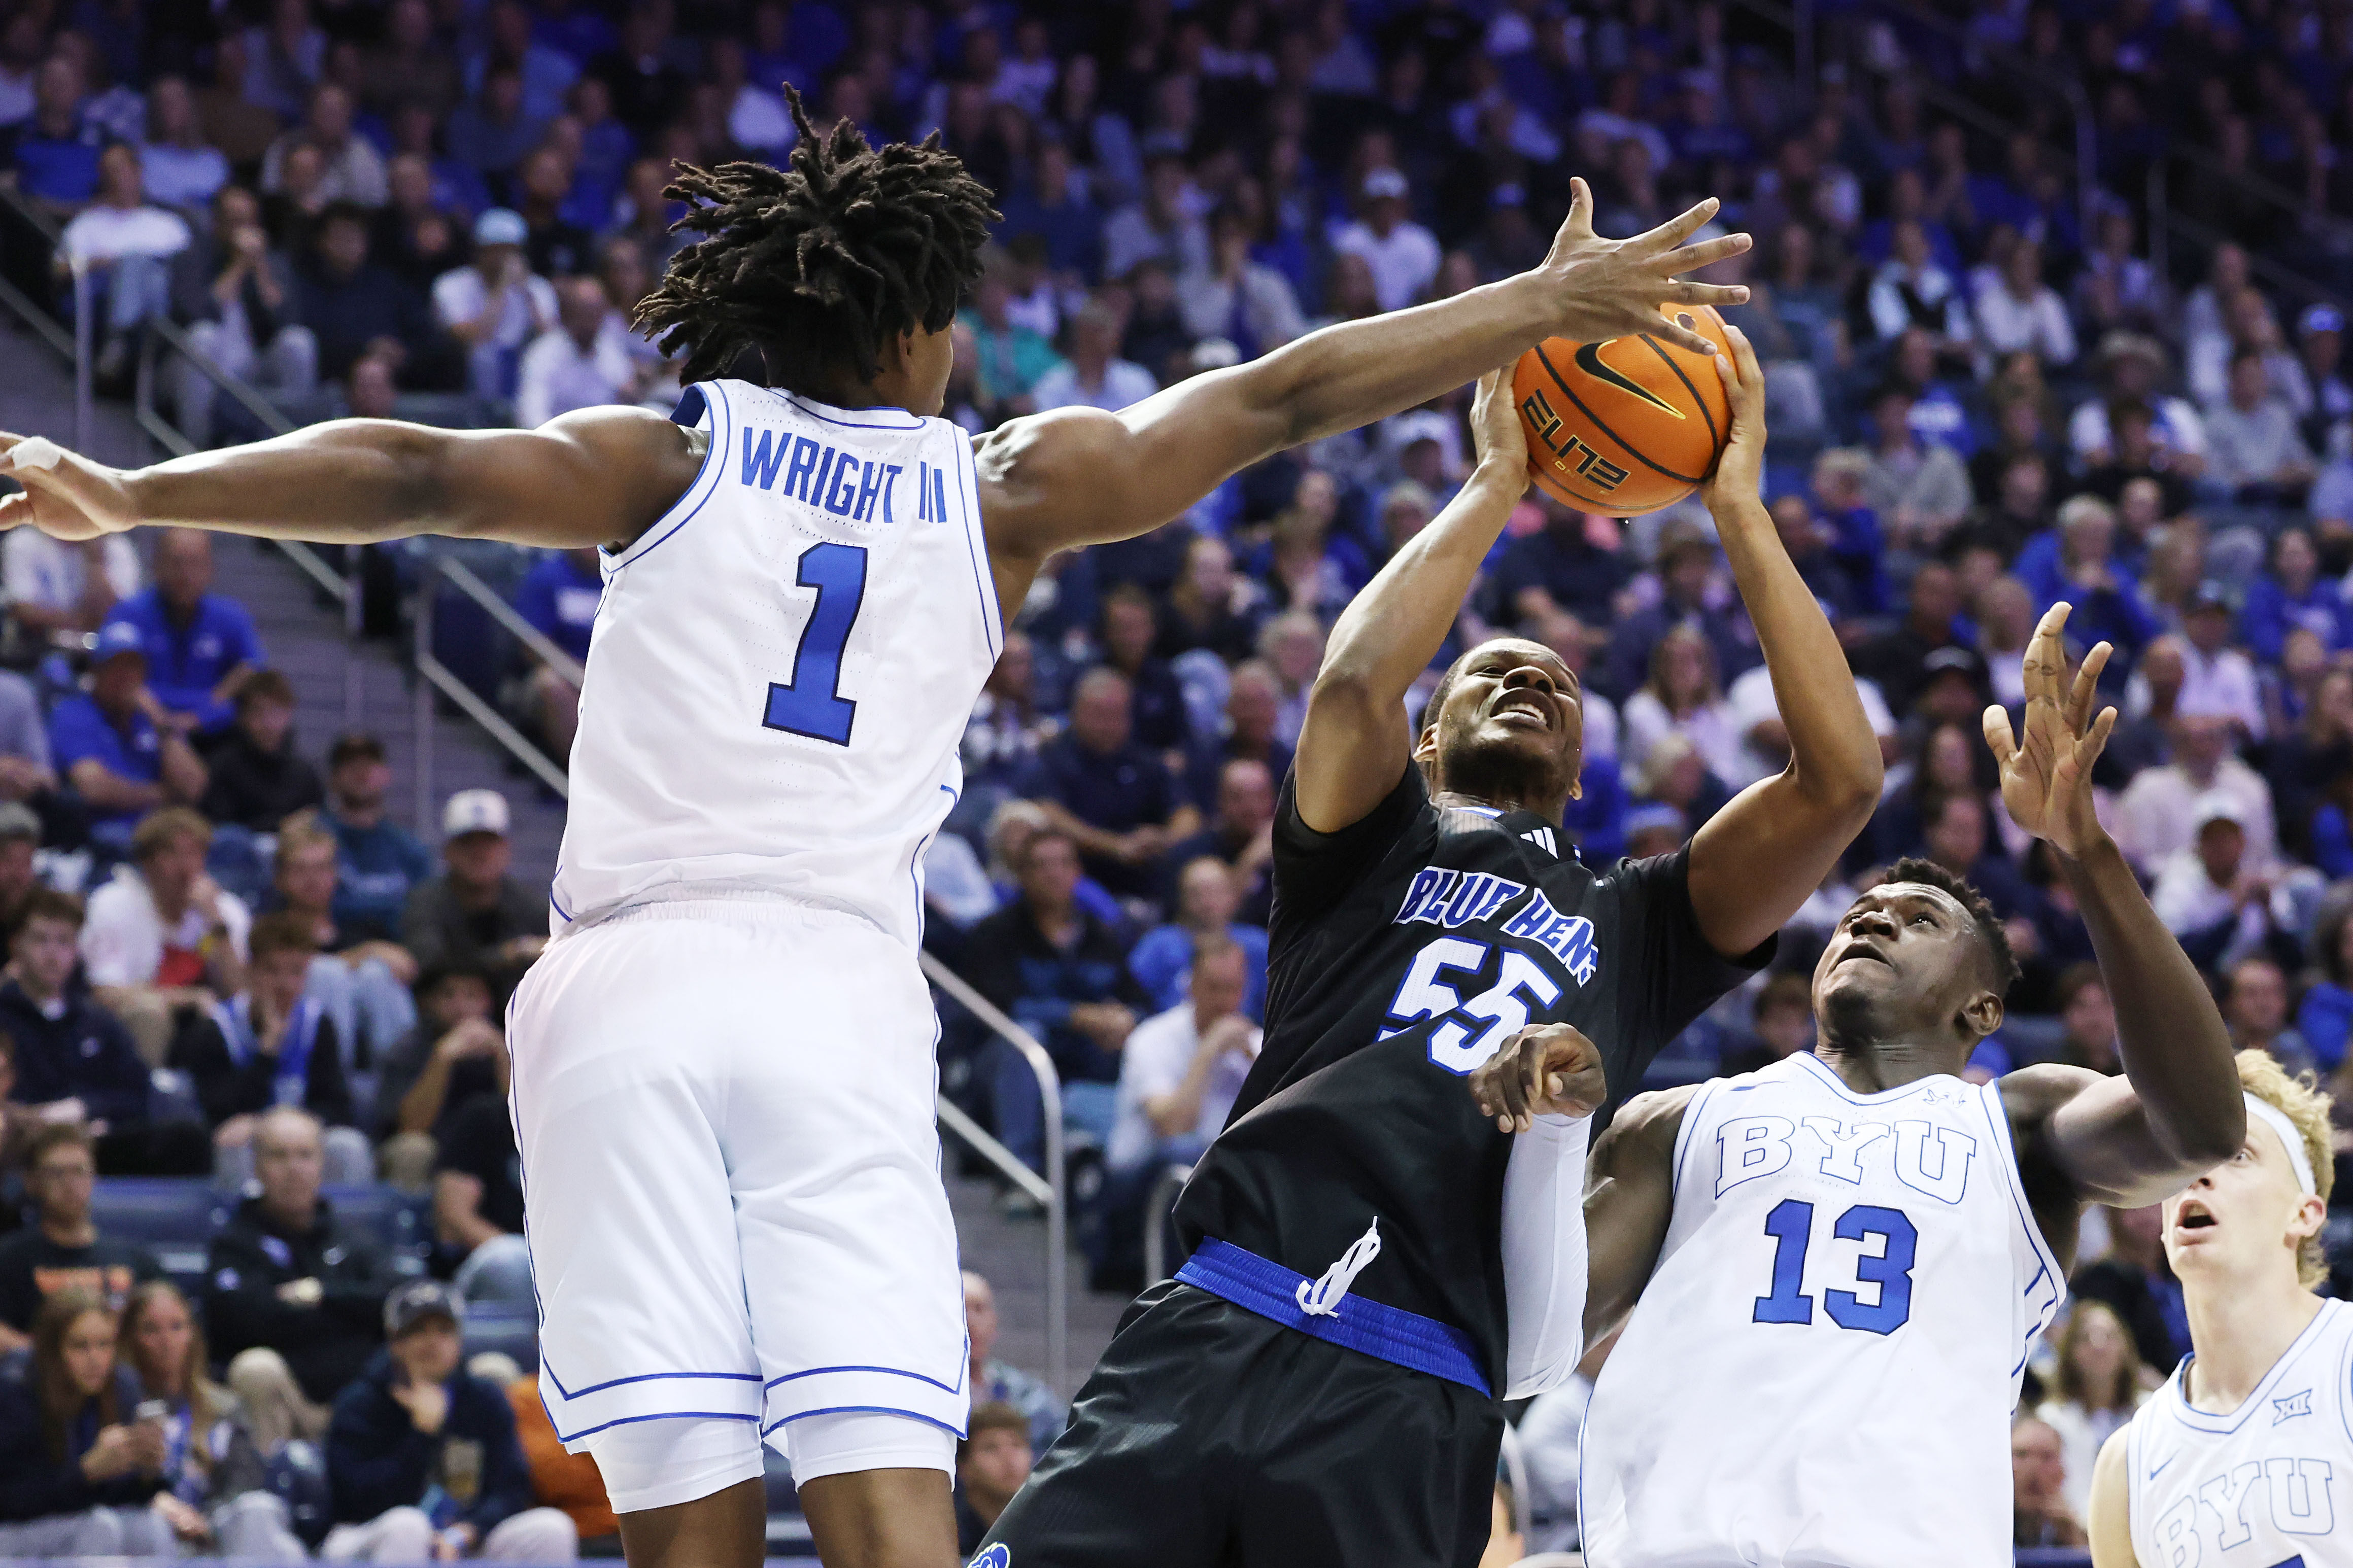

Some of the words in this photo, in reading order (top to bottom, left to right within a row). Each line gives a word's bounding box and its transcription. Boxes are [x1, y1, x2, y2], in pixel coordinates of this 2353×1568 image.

[741, 427, 903, 524] WRIGHT
[1522, 388, 1631, 491] ELITE
[762, 541, 868, 747] 1
[1390, 865, 1527, 929] BLUE
[1372, 934, 1563, 1076] 55
[1715, 1116, 1976, 1205] BYU
[1752, 1198, 1919, 1336] 13
[2153, 1457, 2334, 1568] BYU
